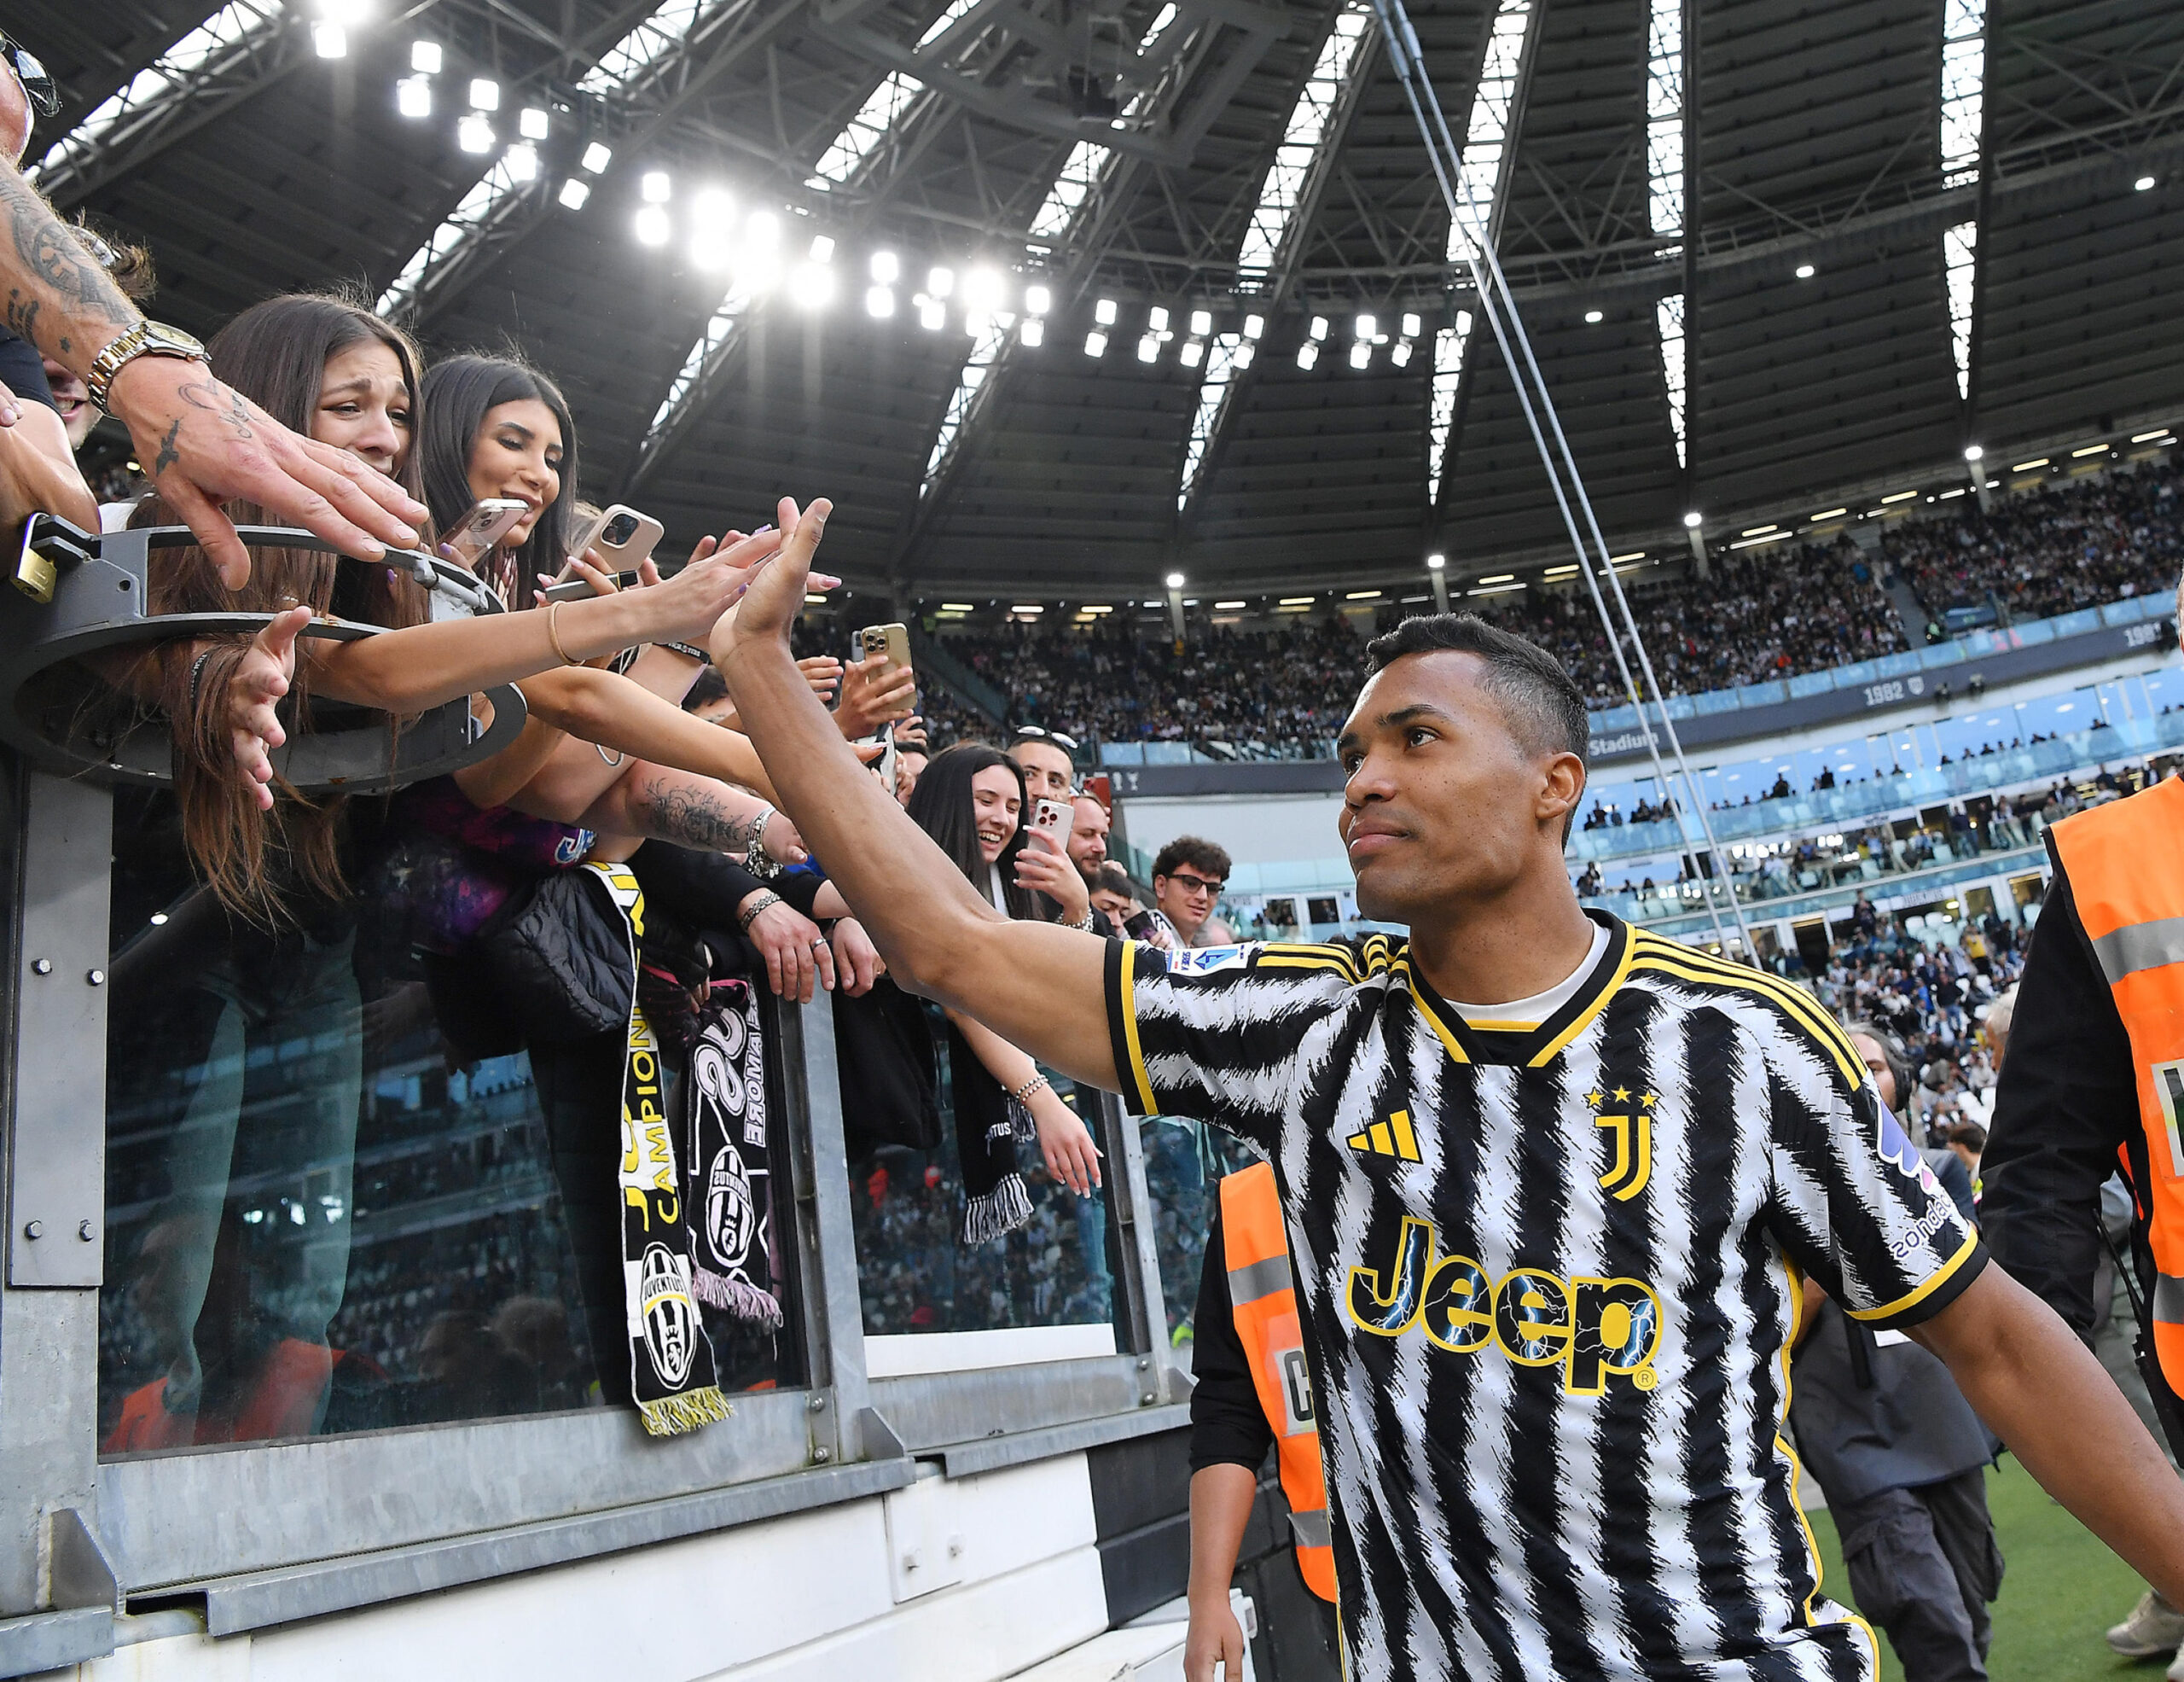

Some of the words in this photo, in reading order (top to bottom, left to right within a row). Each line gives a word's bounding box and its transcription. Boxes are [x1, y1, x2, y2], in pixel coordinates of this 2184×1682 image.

[1891, 1190, 1952, 1258] zondac
[644, 1275, 685, 1301] JUVENTUS
[1346, 1215, 1664, 1396] Jeep
